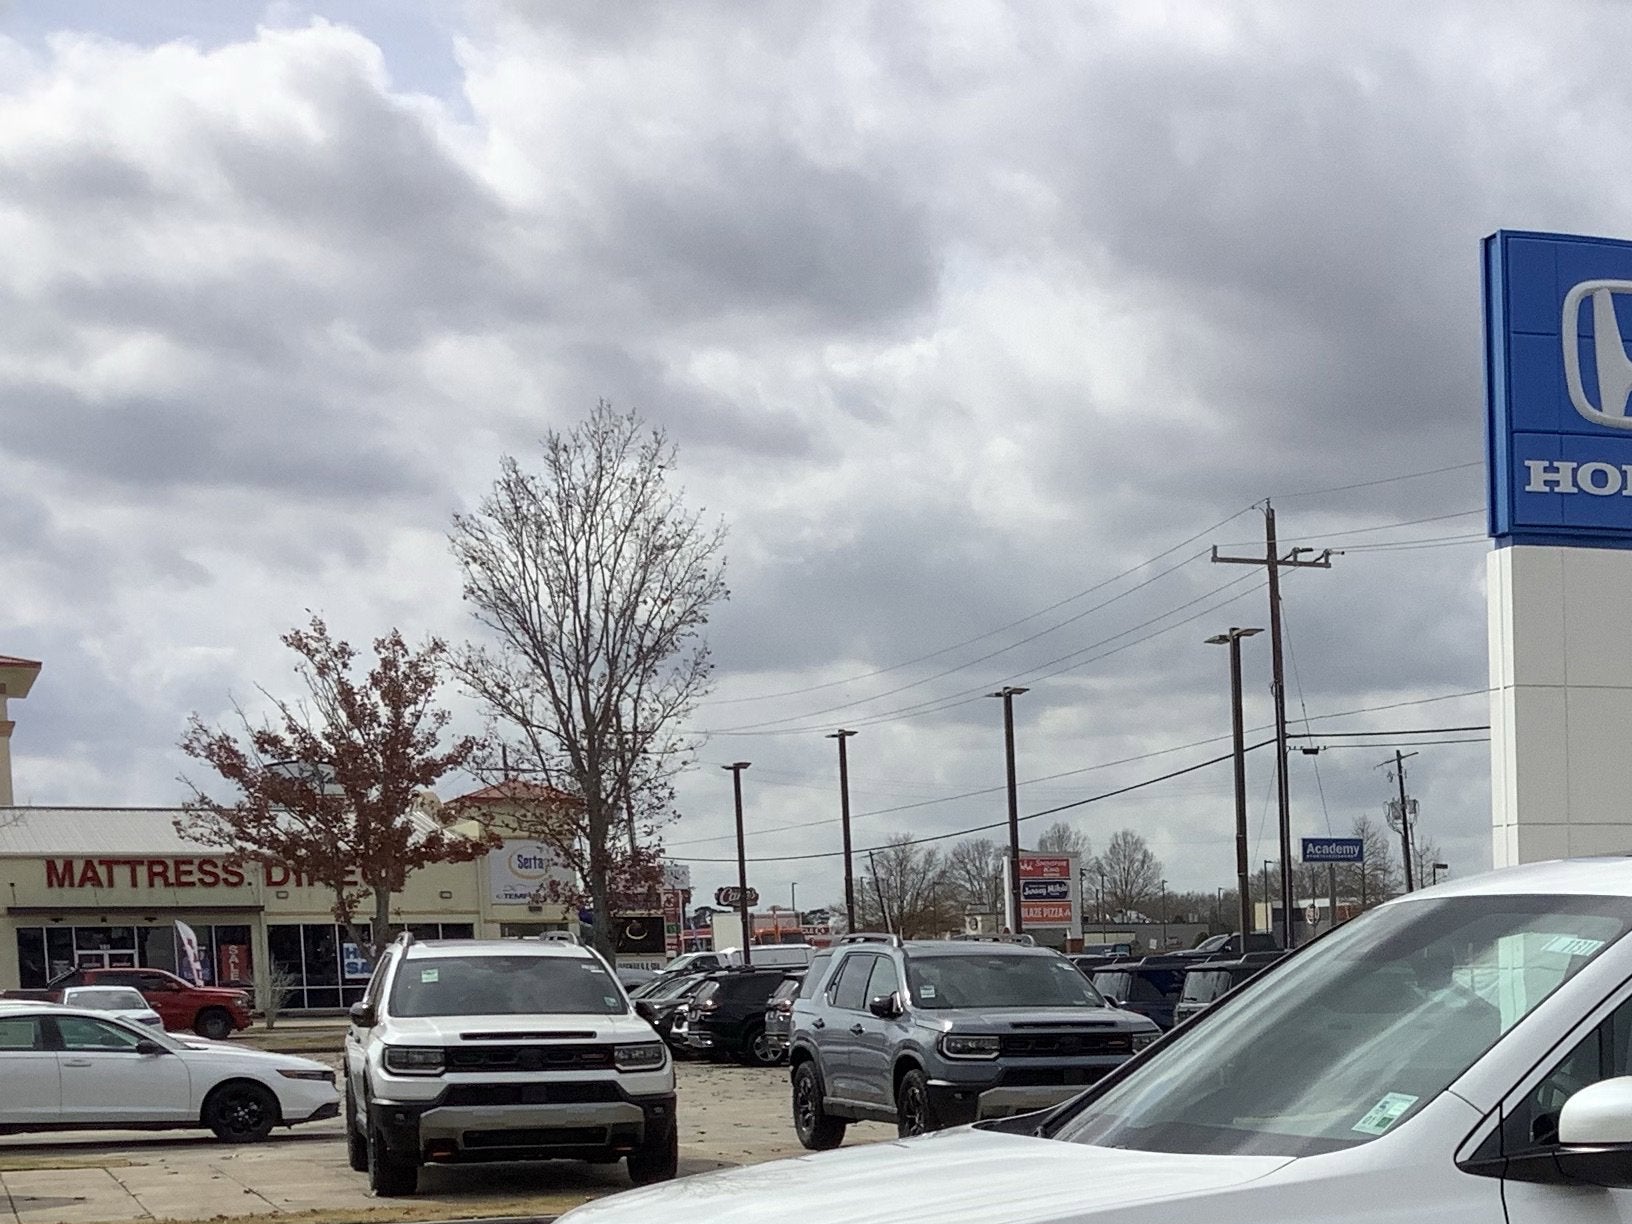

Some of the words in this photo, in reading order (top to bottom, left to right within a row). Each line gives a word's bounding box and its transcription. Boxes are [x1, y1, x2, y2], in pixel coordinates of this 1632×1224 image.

[1306, 843, 1360, 857] Academy
[516, 854, 544, 870] Serta
[45, 858, 245, 888] MATTRESS
[1043, 907, 1063, 918] PIZZA
[228, 945, 240, 981] SALE
